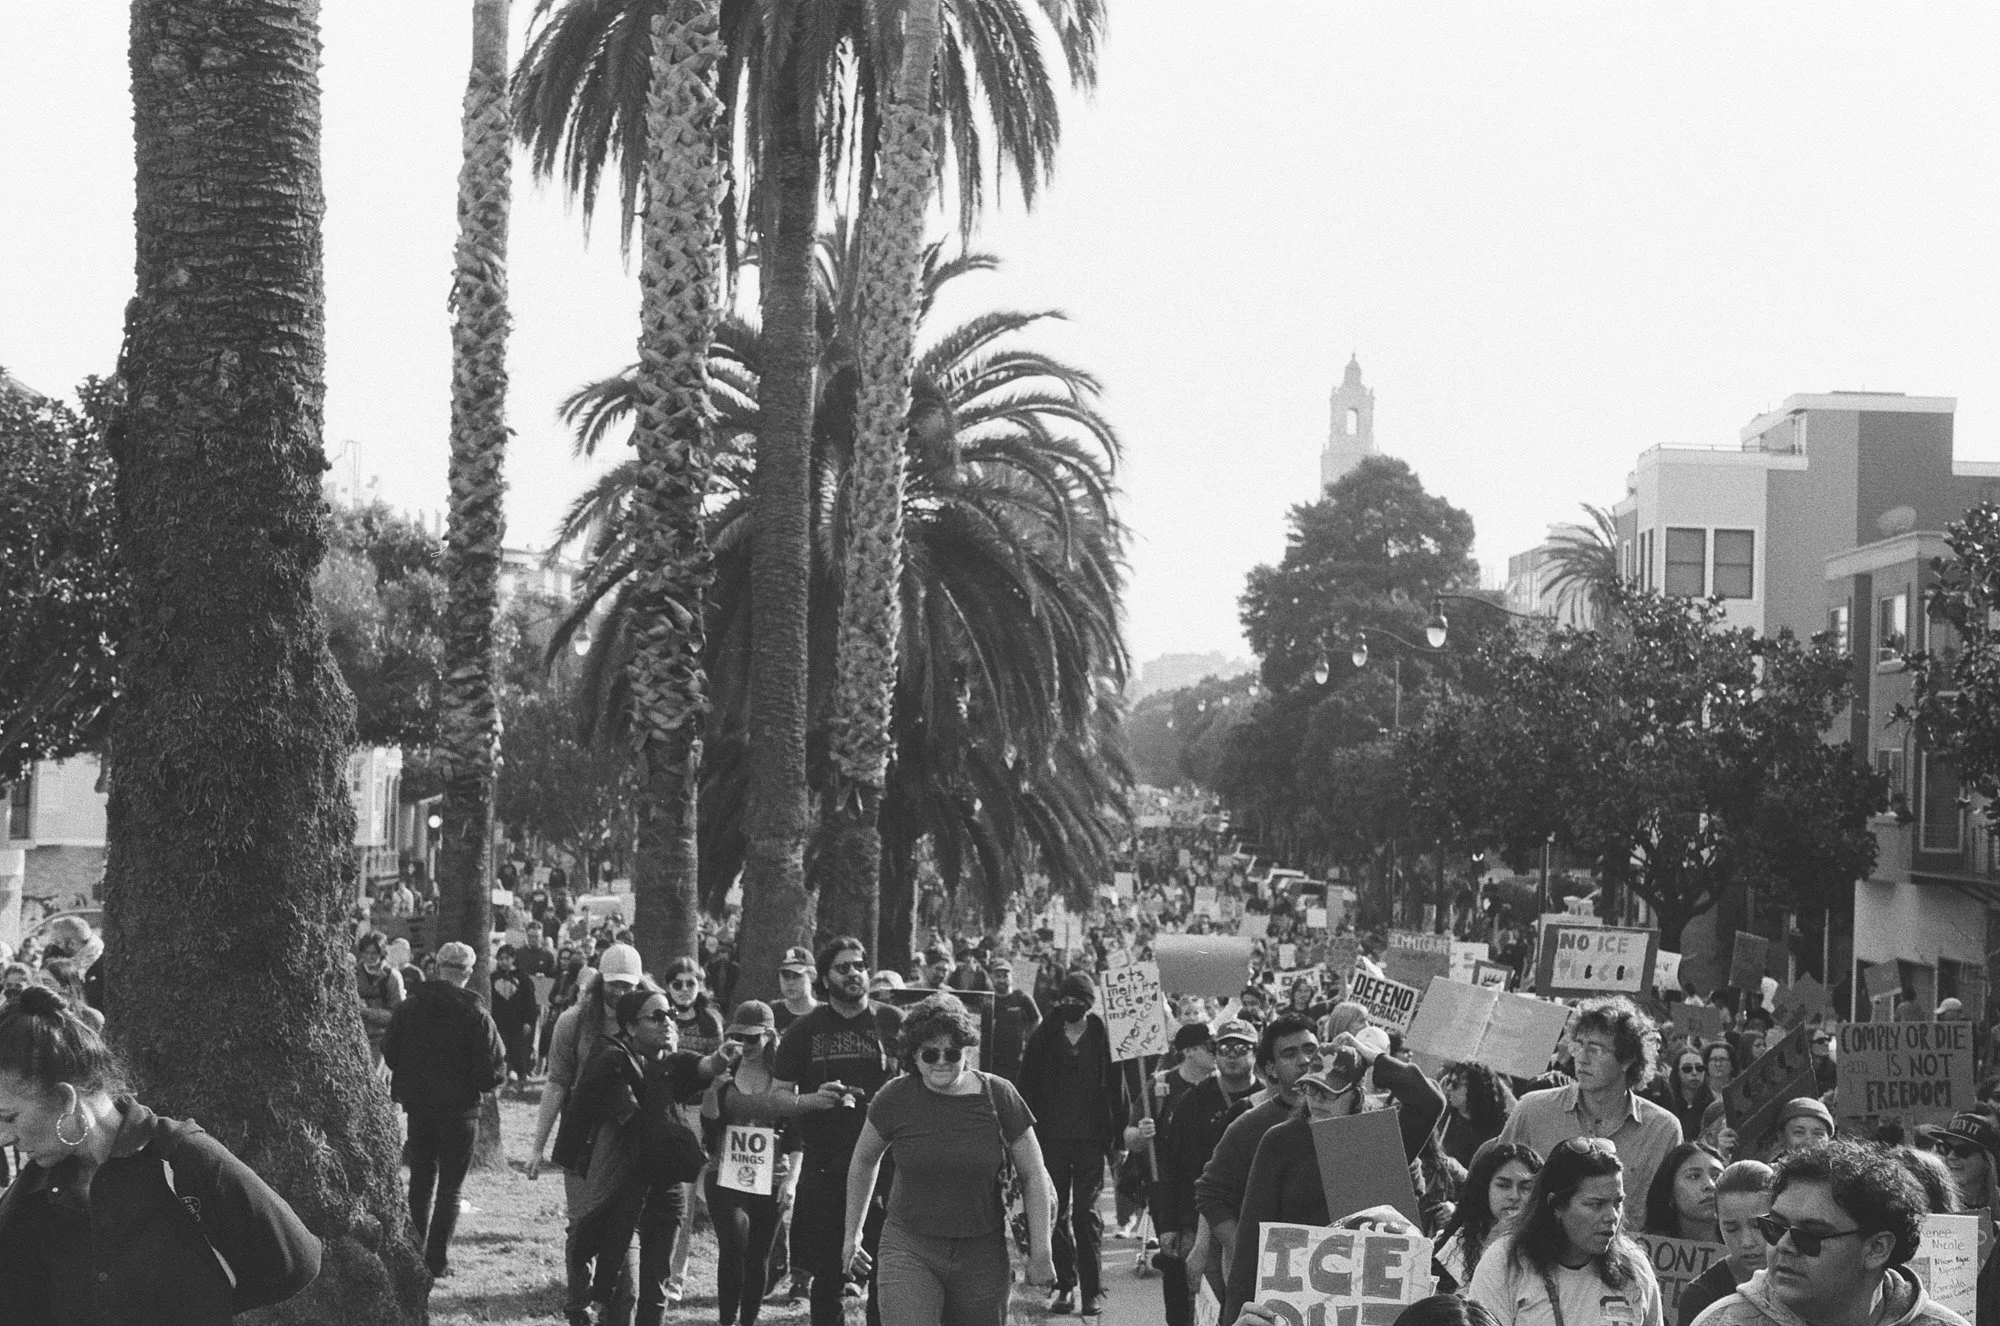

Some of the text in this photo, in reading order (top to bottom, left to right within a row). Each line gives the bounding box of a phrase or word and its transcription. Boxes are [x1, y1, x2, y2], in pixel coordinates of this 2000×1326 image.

[1559, 932, 1630, 954] NO ICE
[1105, 967, 1145, 988] Lets
[1107, 995, 1133, 1010] ICE
[1353, 973, 1415, 1012] DEFEND
[1841, 1023, 1967, 1054] COMPLY OR DIE
[1886, 1053, 1902, 1077] IS
[1909, 1053, 1954, 1078] NOT
[1866, 1080, 1952, 1112] FREEDOM
[731, 1131, 767, 1153] NO
[731, 1153, 765, 1165] KINGS
[1932, 1239, 1965, 1251] Nicole
[1261, 1227, 1410, 1300] ICE
